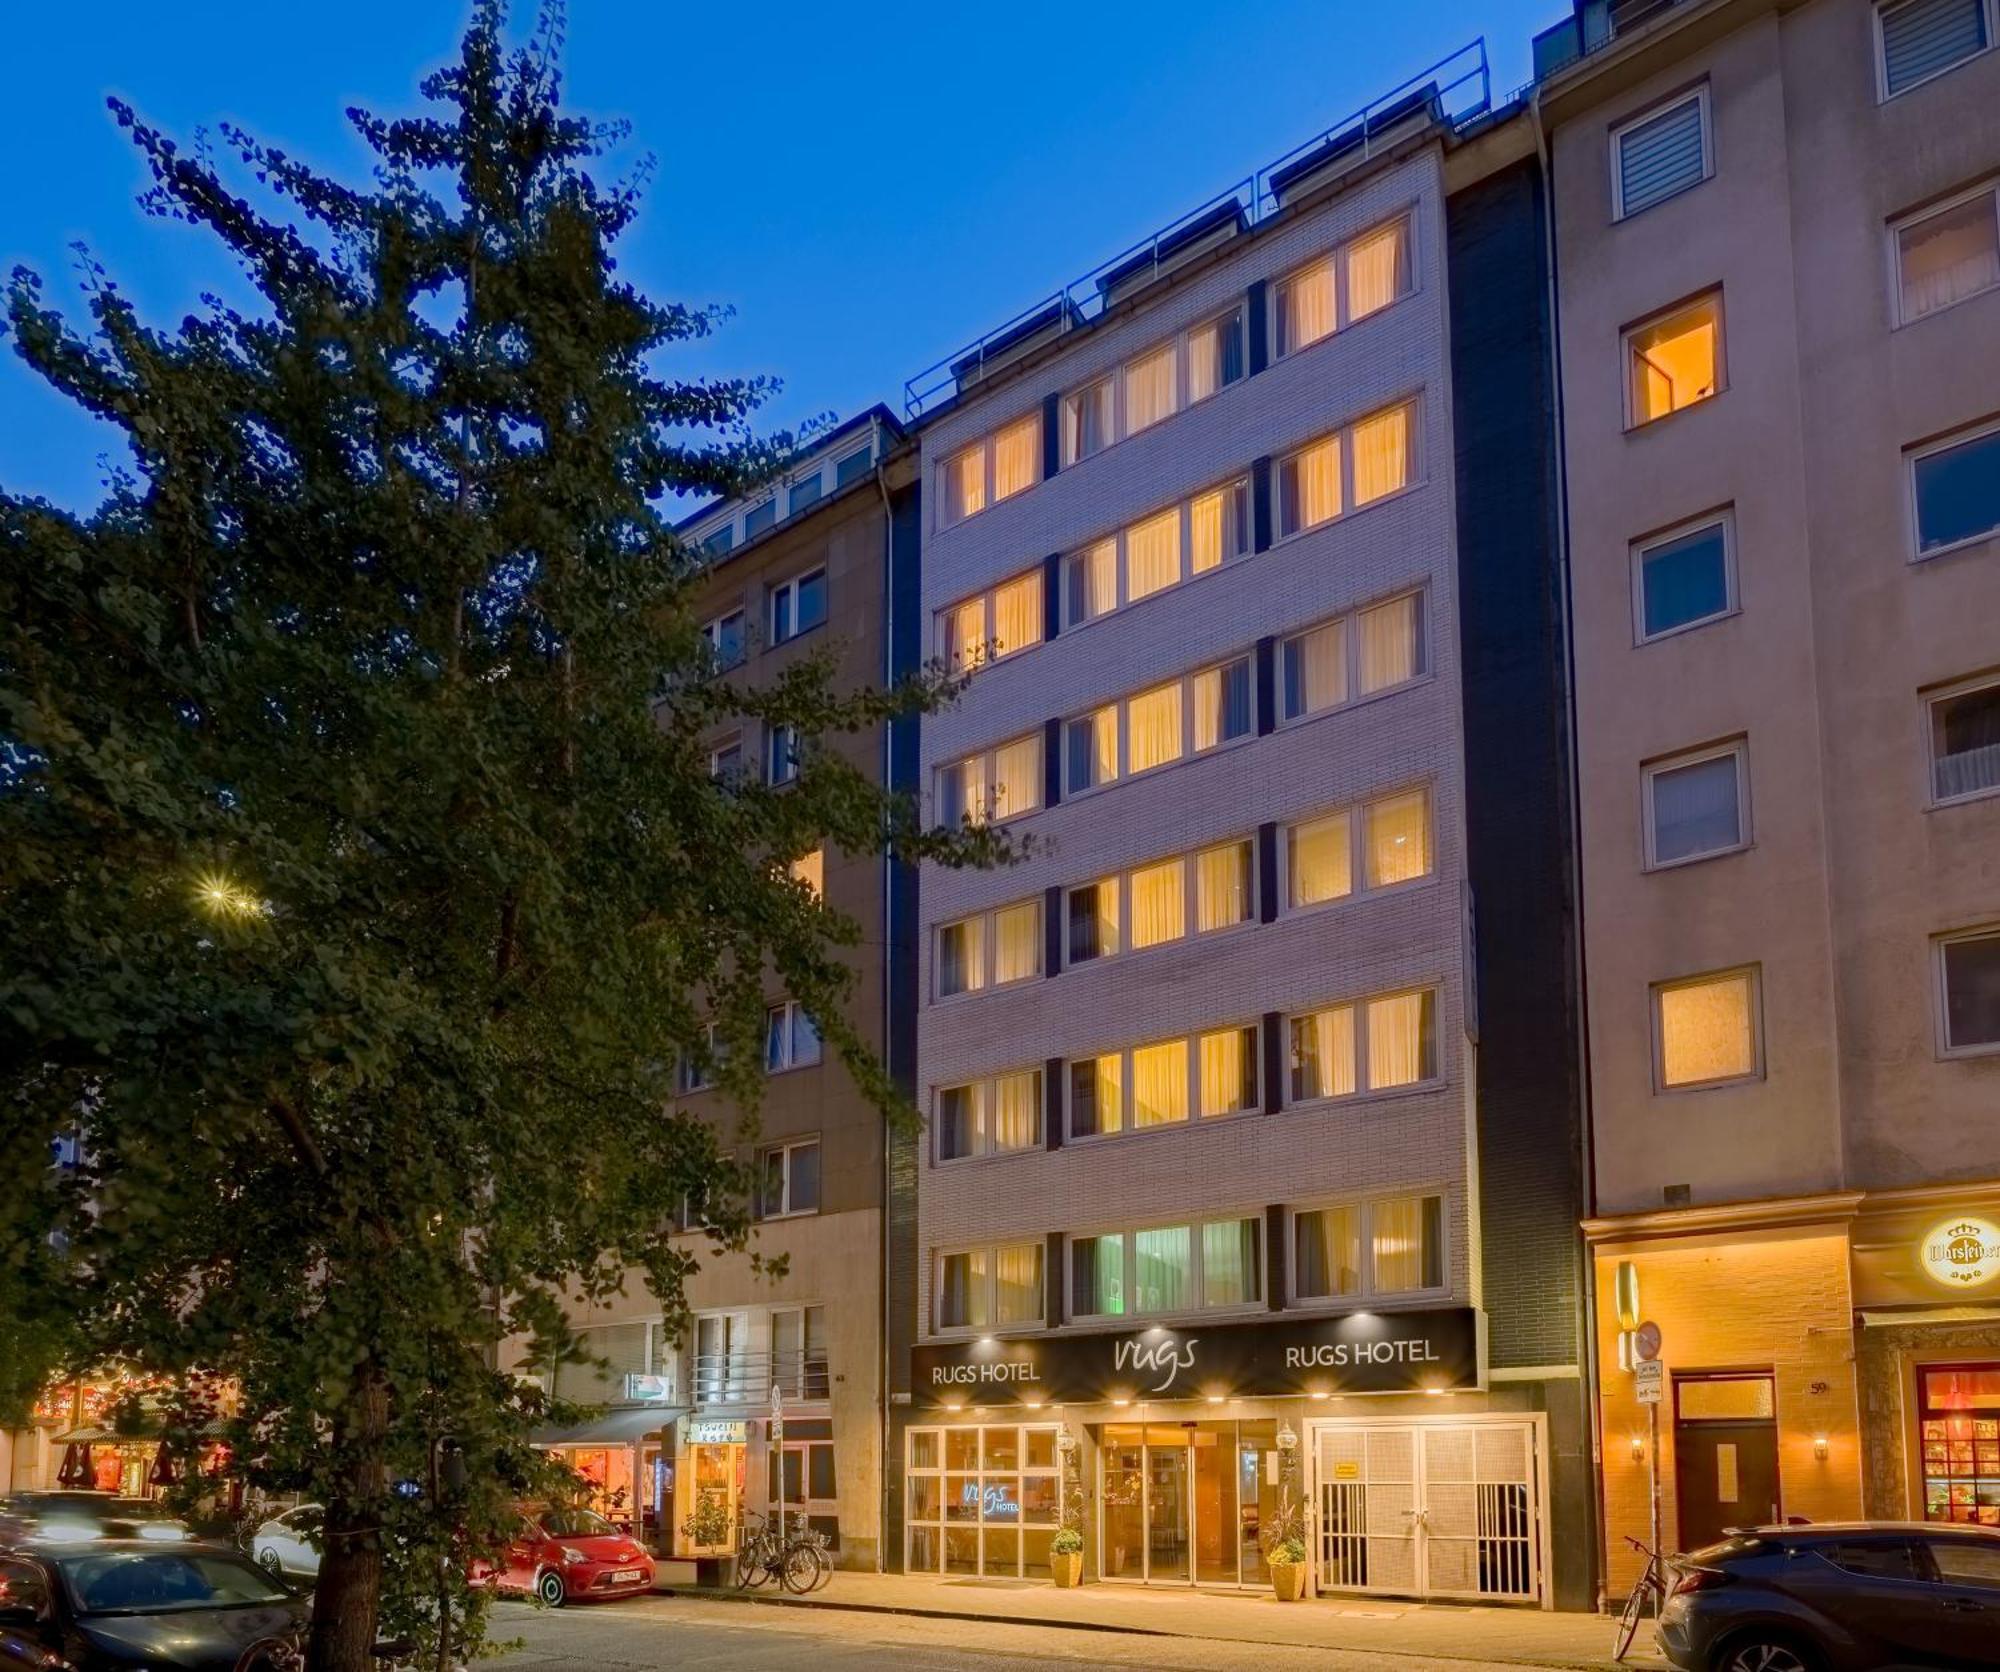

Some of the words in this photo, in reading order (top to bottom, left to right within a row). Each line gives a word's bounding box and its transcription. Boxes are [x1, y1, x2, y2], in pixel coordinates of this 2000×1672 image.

[1115, 1339, 1200, 1392] rugs
[1286, 1344, 1348, 1368] RUGS
[1355, 1339, 1440, 1364] HOTEL
[932, 1365, 977, 1384] RUGS
[980, 1362, 1041, 1382] HOTEL
[1811, 1382, 1826, 1394] 59
